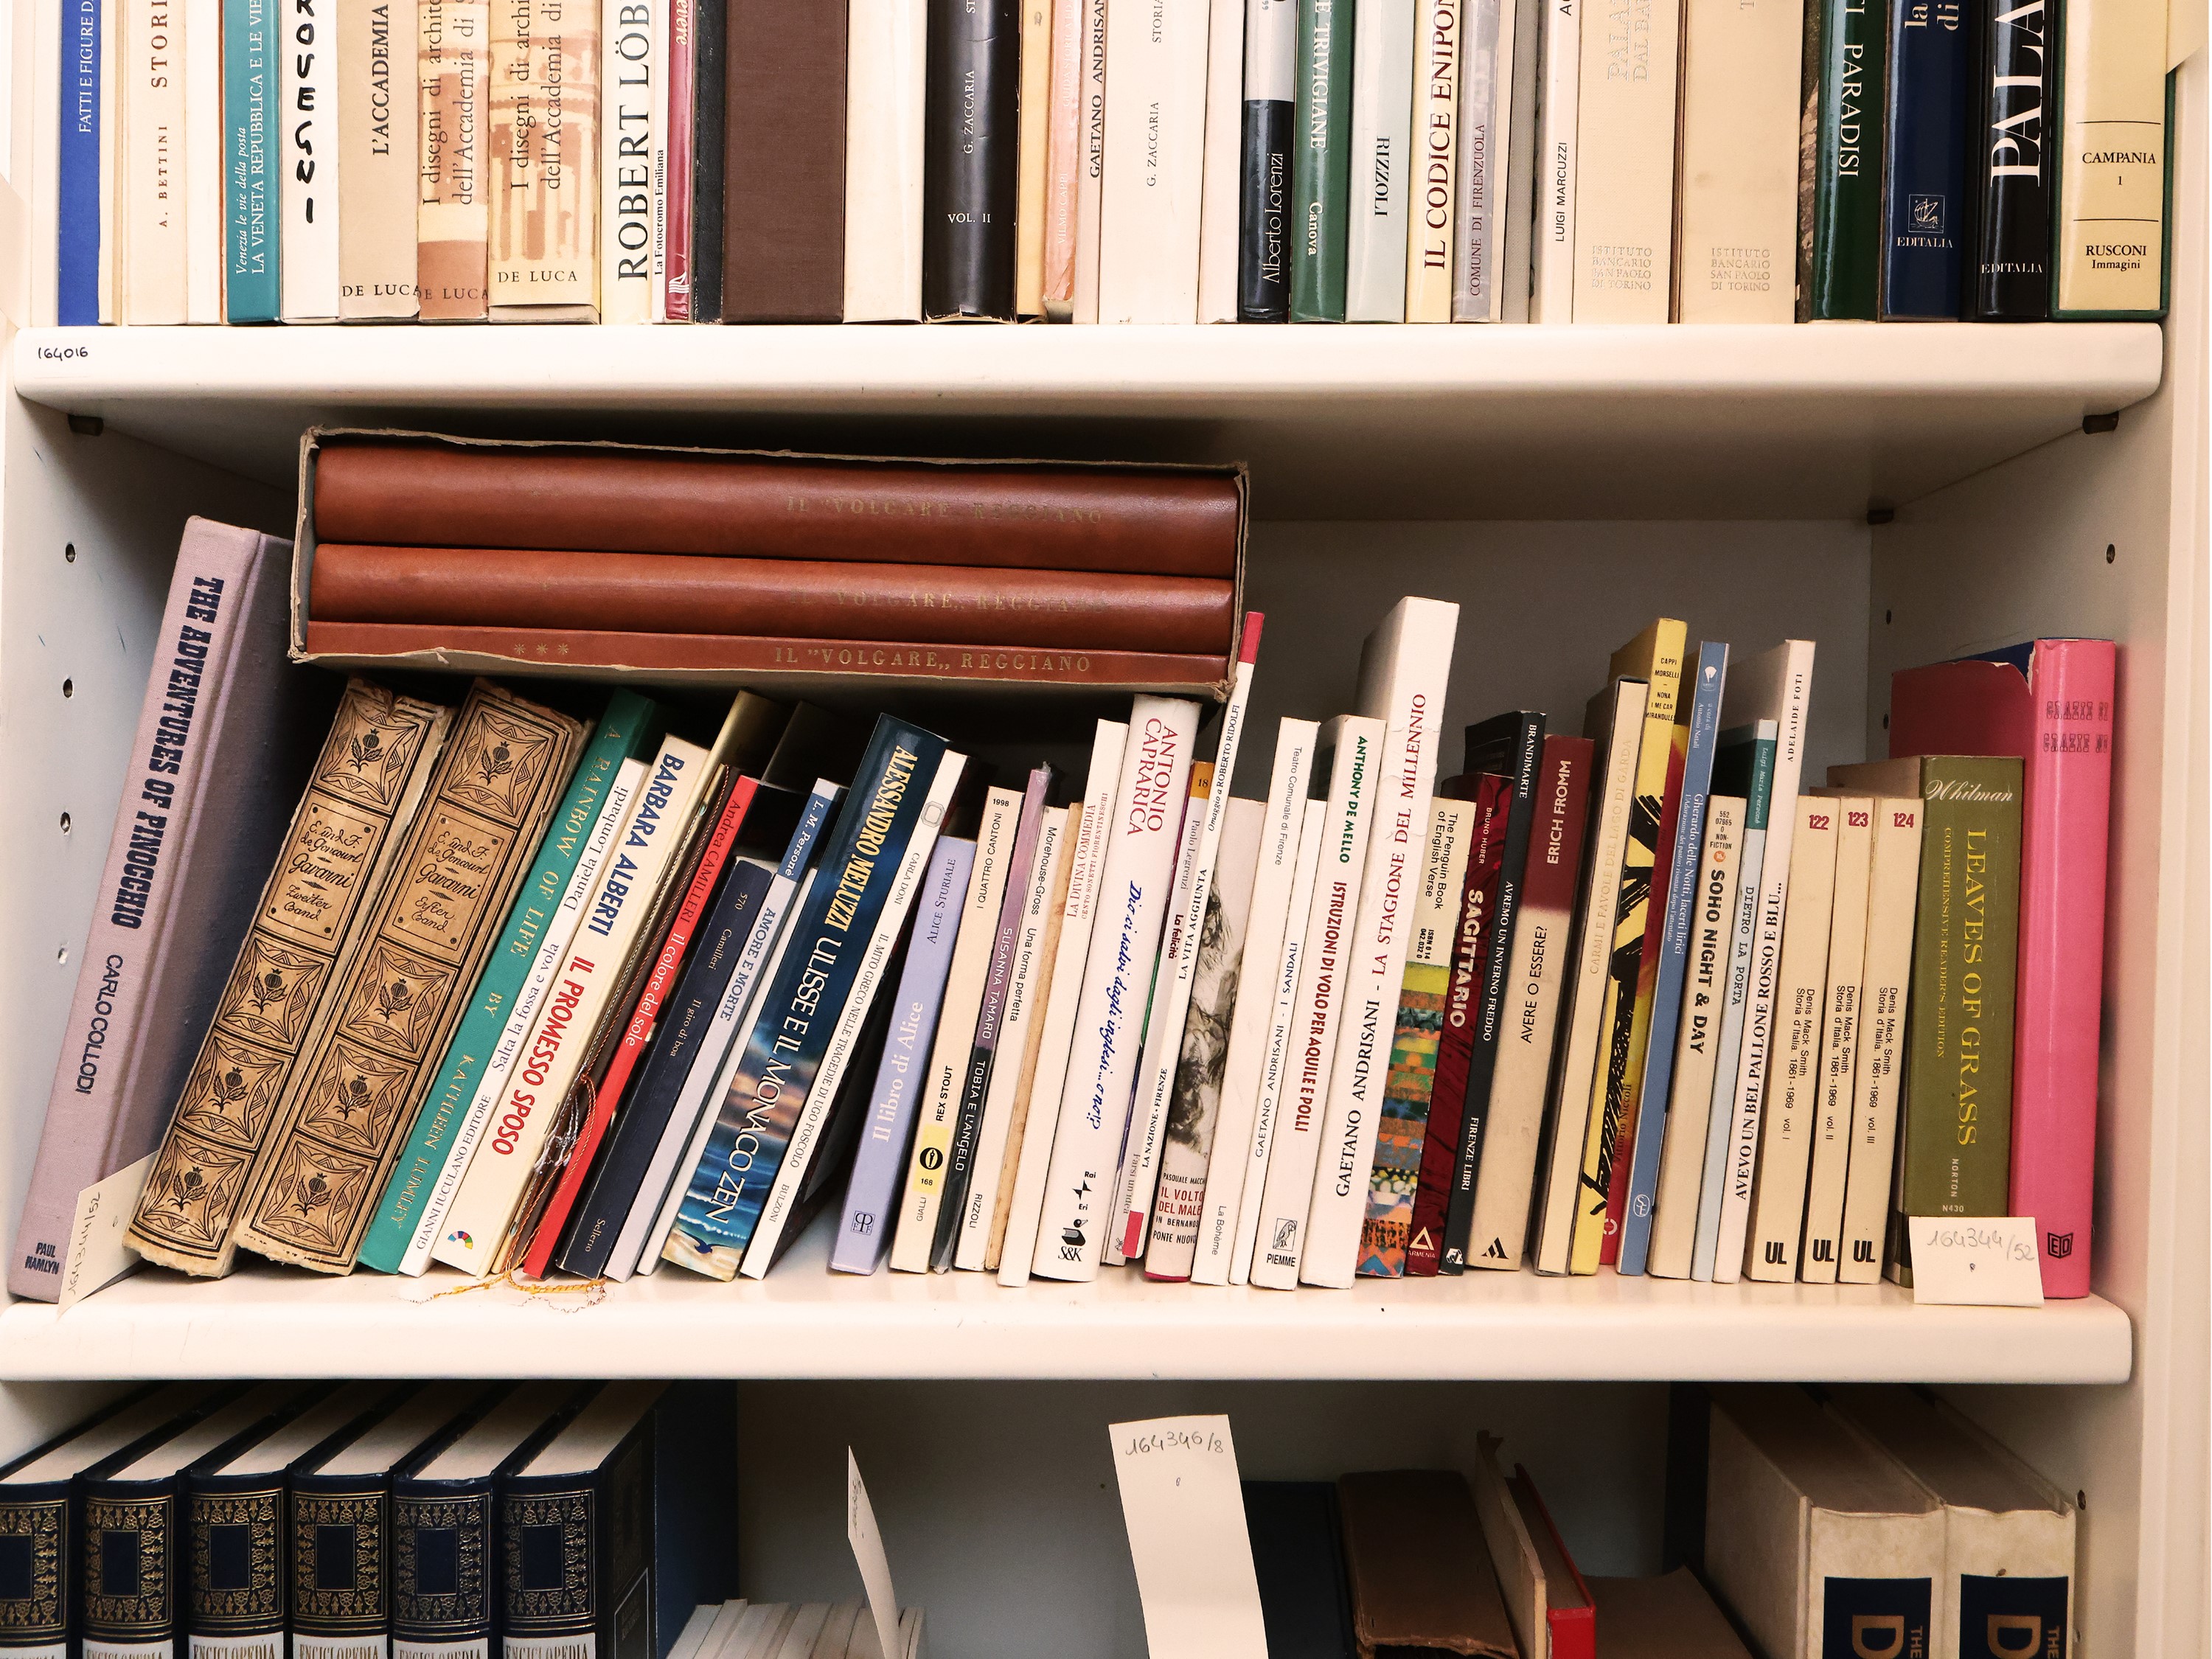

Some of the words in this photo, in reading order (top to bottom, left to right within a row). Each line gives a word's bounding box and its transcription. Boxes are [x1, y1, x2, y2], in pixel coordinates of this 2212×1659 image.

[80, 17, 94, 74] FIGURE
[372, 4, 389, 156] L'ACCADEMIA
[963, 70, 975, 135] ZACCARIA
[79, 93, 92, 133] FATTI
[251, 74, 263, 175] REPUBBLICA
[452, 50, 474, 206] dell'Accademia
[509, 95, 536, 168] disegni
[1838, 42, 1865, 178] PARADISI
[238, 127, 248, 156] posta
[1090, 94, 1103, 178] GAETANO
[2081, 151, 2157, 165] CAMPANIA
[159, 125, 167, 200] BETTINI
[238, 159, 247, 188] della
[655, 149, 664, 196] Emiliana
[1266, 153, 1284, 215] Lorenzi
[1374, 136, 1391, 218] RIZZOLI
[1426, 112, 1450, 229] CODICE
[1473, 123, 1485, 209] FIRENZUOLA
[1556, 142, 1568, 206] MARCUZZI
[251, 181, 265, 249] VENETA
[618, 105, 649, 282] ROBERT
[947, 213, 975, 224] VOL.
[982, 213, 991, 223] II
[236, 225, 248, 274] Venezia
[1307, 201, 1324, 257] Canova
[1555, 208, 1565, 242] LUIGI
[1896, 237, 1954, 248] EDITALIA
[1262, 218, 1282, 284] Alberto
[1425, 239, 1446, 271] IL
[1470, 239, 1481, 296] COMUNE
[1711, 248, 1770, 258] ISTITUTO
[2085, 244, 2147, 258] RUSCONI
[2091, 259, 2141, 271] Immagini
[498, 271, 519, 282] DE
[530, 271, 578, 282] LUCA
[1728, 282, 1770, 291] TORINO
[38, 347, 88, 361] 164016
[185, 575, 226, 625] THE
[773, 647, 799, 664] IL
[960, 653, 1092, 673] REGGIANO
[147, 625, 212, 776] ADVENTURES
[1787, 705, 1799, 762] ADELAIDE
[1793, 672, 1803, 700] FOTI
[1216, 742, 1231, 788] ROBERTO
[1229, 705, 1240, 741] RIDOLFI
[1290, 746, 1303, 774] Teatro
[1347, 736, 1368, 799] ANTHONY
[1520, 724, 1537, 799] BRANDIMARTE
[140, 777, 176, 811] OF
[625, 753, 686, 847] BARBARA
[855, 745, 919, 857] ALESSANDRO
[1127, 717, 1163, 836] CAPRARICA
[1147, 725, 1178, 832] ANTONIO
[1555, 759, 1572, 815] FROMM
[1925, 779, 2013, 803] Whitman
[555, 755, 612, 859] RAINBOW
[712, 799, 741, 849] Andrea
[992, 799, 1009, 807] 1998
[1448, 813, 1458, 834] The
[1483, 807, 1493, 835] BRUNO
[1689, 793, 1705, 841] Gherardo
[1809, 814, 1830, 831] 122
[1893, 813, 1915, 828] 124
[1076, 804, 1096, 858] COMMEDIA
[1340, 820, 1355, 864] MELLO
[1430, 825, 1444, 864] English
[1478, 838, 1488, 864] HUBER
[1546, 821, 1564, 865] ERICH
[1710, 841, 1733, 849] FICTION
[110, 810, 169, 931] PINOCCHIO
[978, 858, 994, 903] QUATTRO
[987, 813, 1003, 855] CANTONI
[1031, 826, 1057, 916] Morehouse-Gross
[1425, 866, 1438, 898] Verse
[1440, 836, 1455, 879] Penguin
[588, 853, 639, 937] ALBERTI
[680, 850, 719, 924] CAMILLERI
[824, 854, 874, 932] MELUZZI
[935, 858, 957, 908] STURIALE
[1187, 869, 1208, 931] AGGIUNTA
[1434, 881, 1447, 910] Book
[1500, 881, 1514, 926] AVREMO
[1705, 869, 1725, 922] SOHO
[1963, 827, 1988, 964] LEAVES
[750, 907, 777, 959] AMORE
[1324, 882, 1347, 955] ISTRUZIONI
[1740, 886, 1755, 934] DIETRO
[708, 928, 732, 970] Camilleri
[992, 927, 1013, 986] SUSANNA
[1335, 1110, 1363, 1197] GAETANO
[1353, 999, 1380, 1102] ANDRISANI
[1377, 852, 1405, 945] STAGIONE
[1400, 694, 1426, 799] MILLENNIO
[1425, 929, 1434, 943] ISBN
[1450, 888, 1484, 1028] SAGITTARIO
[1528, 925, 1548, 978] ESSERE?
[94, 953, 124, 1016] CARLO
[790, 936, 842, 1018] ULISSE
[1282, 942, 1298, 994] SANDALI
[1492, 943, 1505, 995] INVERNO
[1731, 966, 1745, 1006] PORTA
[1757, 945, 1775, 998] ROSSO
[417, 1213, 439, 1250] GIANNI
[462, 1095, 491, 1150] EDITORE
[491, 1037, 517, 1073] Salta
[589, 786, 630, 855] Lombardi
[720, 967, 749, 1021] MORTE
[982, 989, 1001, 1040] TAMARO
[1010, 982, 1023, 1022] perfetta
[1805, 989, 1815, 1015] Denis
[1962, 973, 1983, 1019] OF
[522, 978, 585, 1086] PROMESSO
[625, 1016, 645, 1048] sole
[897, 1002, 924, 1051] Alice
[1690, 1015, 1708, 1054] DAY
[1747, 1004, 1768, 1079] PALLONE
[74, 1016, 110, 1095] COLLODI
[939, 1065, 953, 1102] STOUT
[1868, 1057, 1882, 1108] 1861-1969
[1958, 1027, 1983, 1145] GRASS
[492, 1089, 535, 1155] SPOSO
[728, 1057, 792, 1173] MONACO
[1143, 1113, 1159, 1154] NAZIONE
[1154, 1068, 1168, 1108] FIRENZE
[1295, 1096, 1312, 1133] POLLI
[1084, 1171, 1096, 1179] Rai
[1163, 1172, 1188, 1183] PASQUALE
[1174, 1189, 1205, 1202] VOLTO
[1735, 1144, 1752, 1200] AVEVO
[705, 1172, 745, 1225] ZEN
[768, 1183, 790, 1223] BULZONI
[916, 1197, 927, 1222] GIALLI
[969, 1193, 983, 1229] RIZZOLI
[1158, 1201, 1175, 1214] DEL
[1178, 1203, 1202, 1216] MALE
[1942, 1204, 1964, 1213] N430
[35, 1241, 57, 1257] PAUL
[1058, 1246, 1082, 1262] S&K
[1152, 1230, 1172, 1242] PONTE
[1212, 1219, 1225, 1255] Bohème
[1266, 1253, 1296, 1267] PIEMME
[1408, 1250, 1436, 1258] ARMENIA
[1765, 1241, 1788, 1265] UL
[24, 1256, 60, 1275] HAMLYN
[1125, 1430, 1224, 1456] 164346/8
